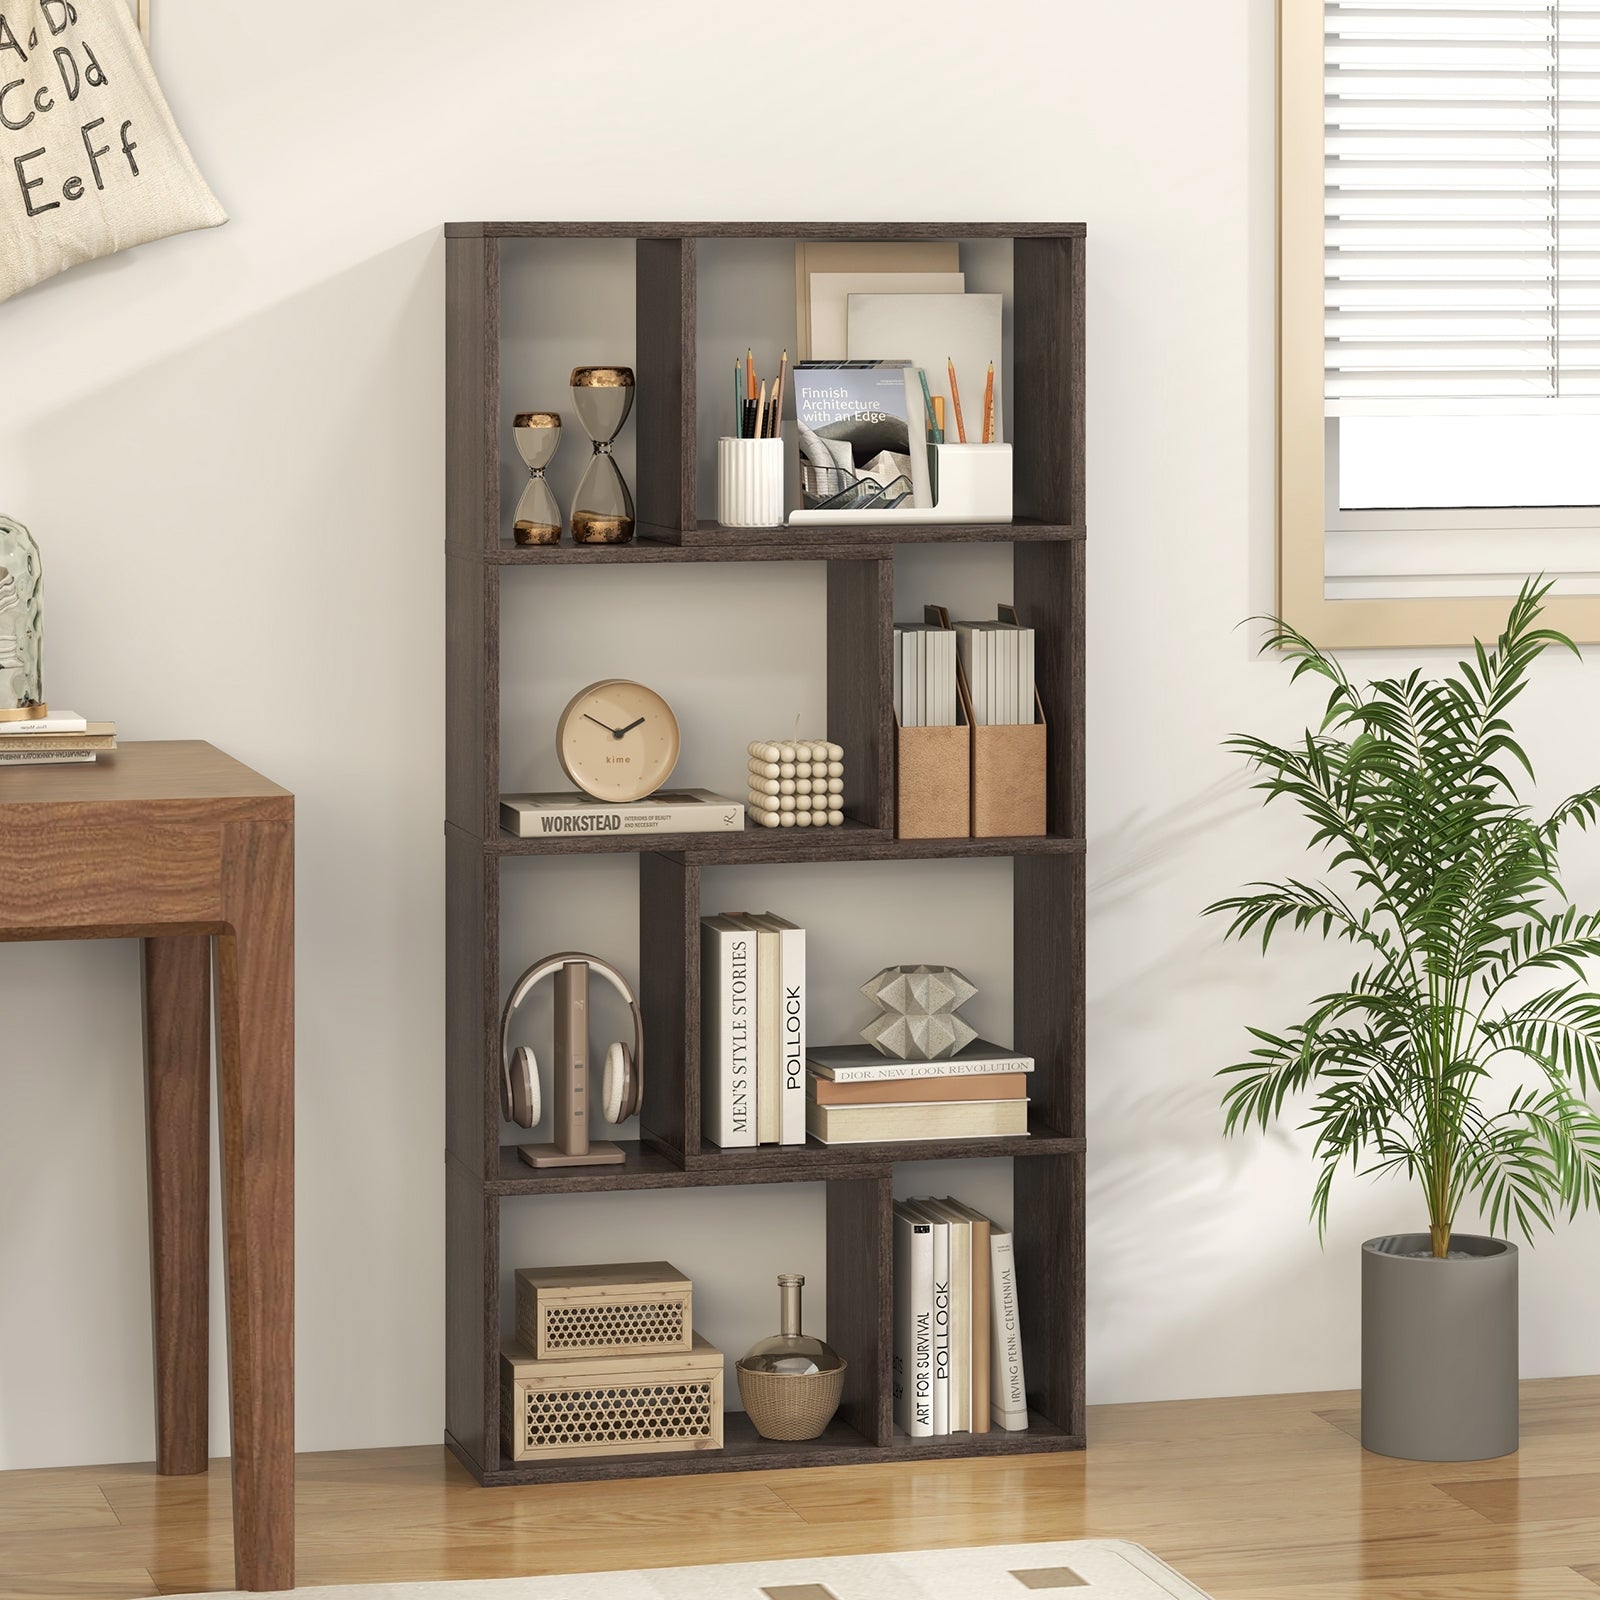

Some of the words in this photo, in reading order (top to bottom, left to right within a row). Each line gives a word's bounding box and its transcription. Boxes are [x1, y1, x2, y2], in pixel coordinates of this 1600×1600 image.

[801, 387, 848, 398] Finnish
[802, 399, 880, 410] Architecture
[803, 411, 831, 422] with
[835, 413, 851, 422] an
[854, 411, 886, 424] Edge
[606, 755, 631, 764] kime
[540, 814, 622, 833] WORKSTEAD
[732, 941, 747, 1015] STORIES
[732, 1019, 748, 1075] STYLE
[786, 985, 801, 1090] POLLOCK
[878, 1068, 907, 1079] NEW
[910, 1066, 945, 1077] LOOK
[948, 1061, 1030, 1074] REVOLUTION
[732, 1079, 748, 1133] MEN'S
[1001, 1268, 1015, 1331] CENTENNIAL
[916, 1312, 930, 1369] SURVIVAL
[936, 1281, 949, 1380] POLLOCK
[916, 1372, 930, 1398] FOR
[1009, 1364, 1021, 1403] IRVING
[916, 1402, 930, 1425] ART
